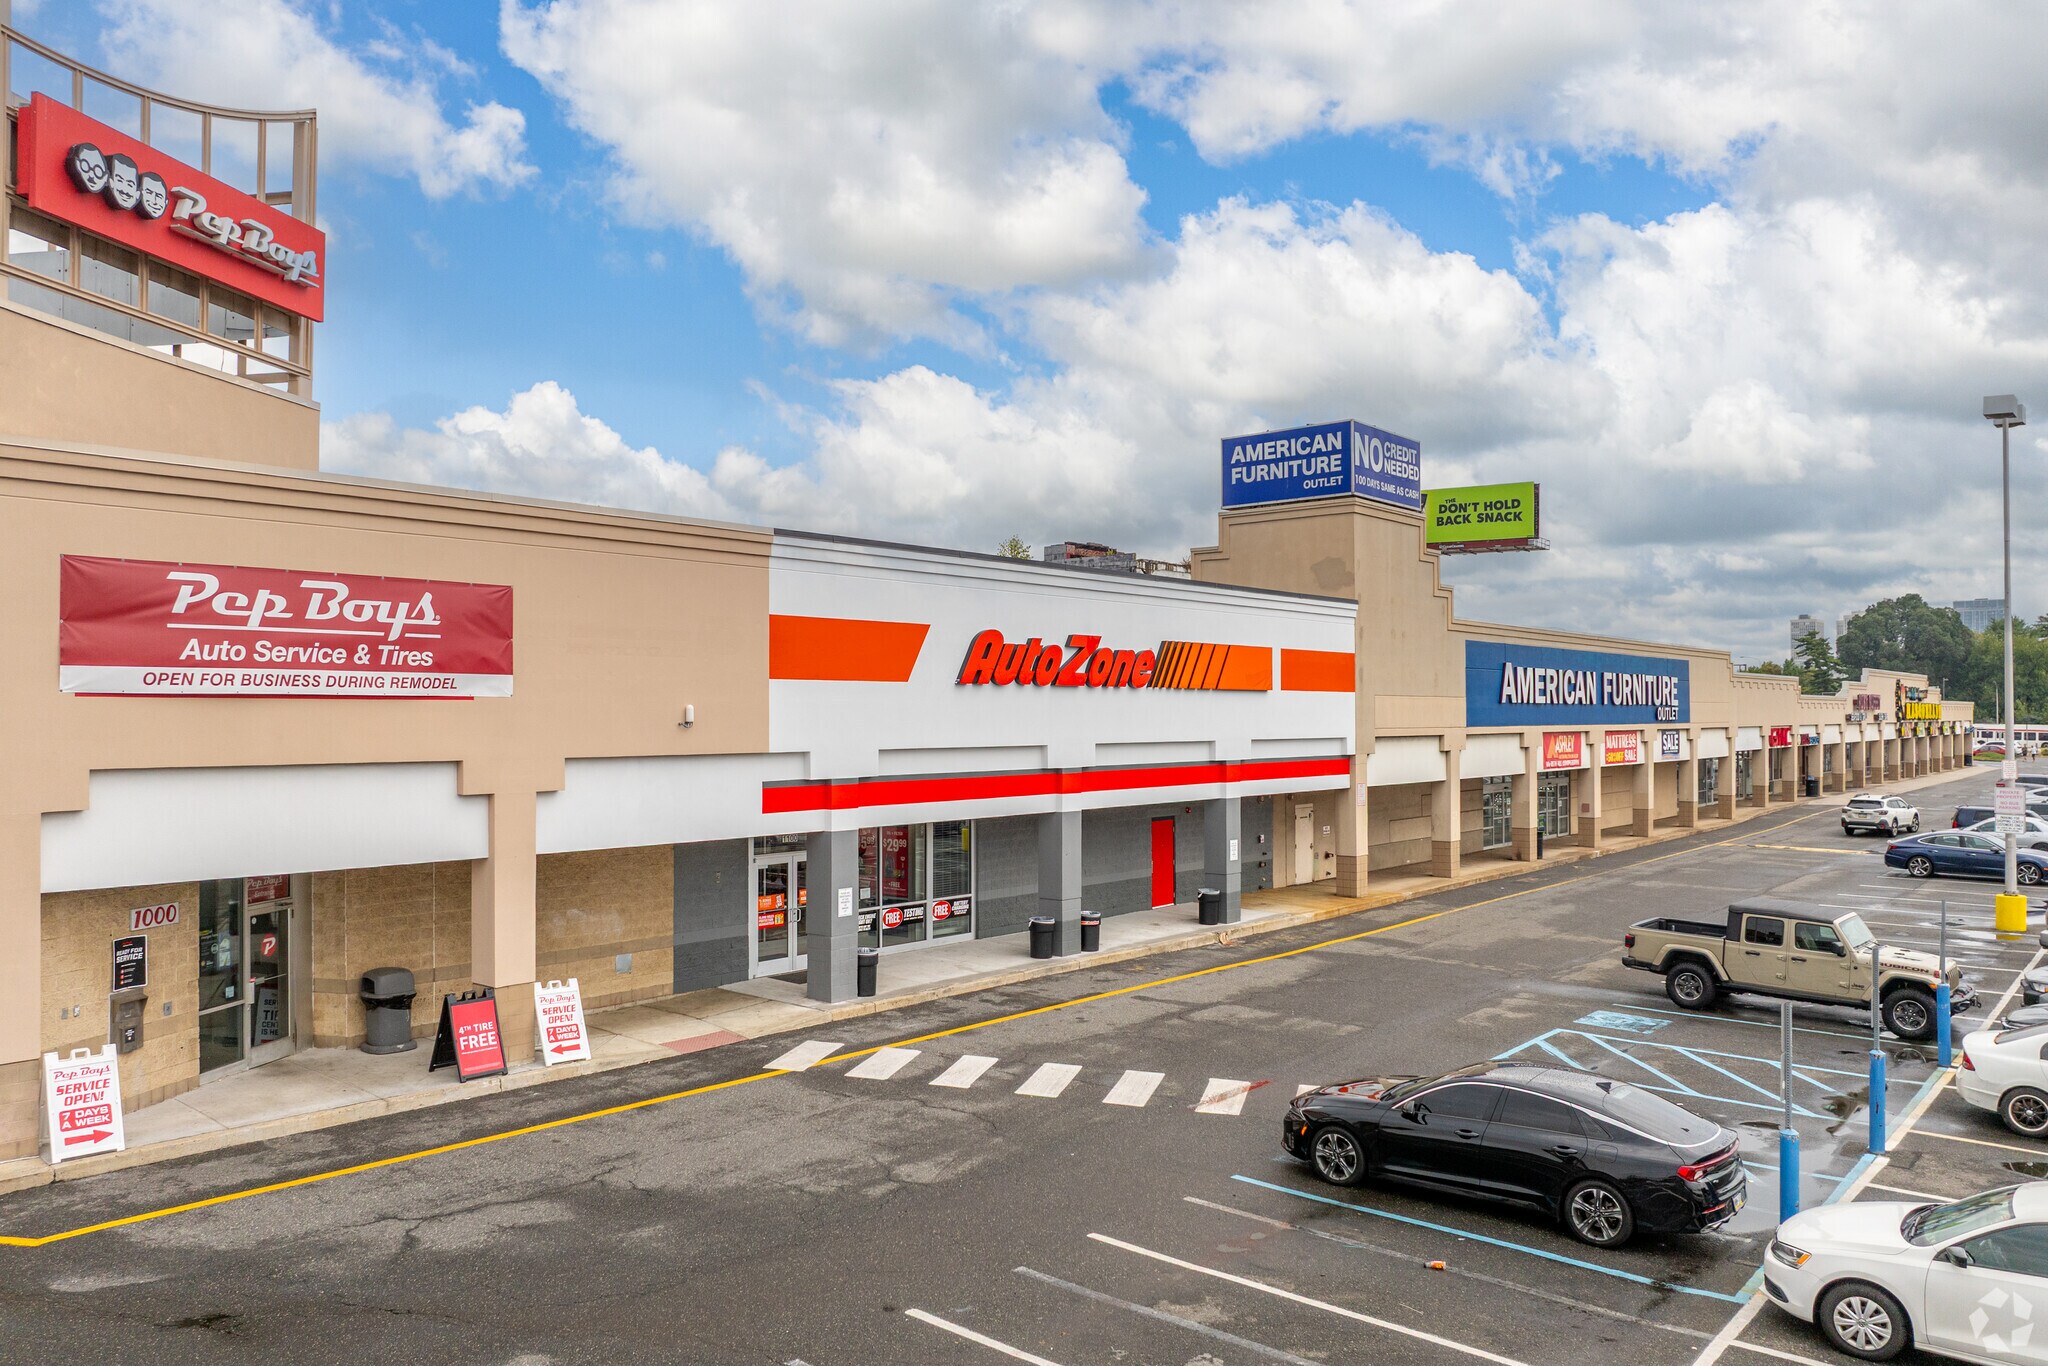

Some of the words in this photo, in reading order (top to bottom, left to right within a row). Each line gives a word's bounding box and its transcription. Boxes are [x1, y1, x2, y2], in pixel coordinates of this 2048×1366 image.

[171, 186, 244, 245] Pep
[241, 219, 319, 281] Boys
[1231, 431, 1342, 464] AMERICAN
[1354, 431, 1384, 473] NO
[1384, 441, 1417, 464] CREDIT
[1231, 454, 1342, 485] FURNITURE
[1384, 457, 1420, 481] NEEDED
[1303, 475, 1343, 490] OUTLET
[1355, 474, 1366, 486] 100
[1366, 477, 1380, 490] DAYS
[1380, 481, 1395, 494] SAME
[1396, 486, 1404, 496] AS
[1404, 487, 1419, 500] CASH
[1438, 502, 1479, 514] DON'T
[1483, 499, 1521, 511] HOLD
[1436, 513, 1472, 527] BACK
[1476, 511, 1523, 523] SNACK
[166, 571, 294, 628] Pep
[300, 579, 441, 642] Boys
[179, 638, 247, 662] Auto
[253, 640, 347, 664] Service
[353, 644, 371, 665] &
[378, 645, 434, 667] Tires
[955, 628, 1156, 689] AutoZone
[142, 671, 194, 687] OPEN
[200, 673, 235, 687] FOR
[241, 674, 321, 688] BUSINESS
[325, 676, 385, 690] DURING
[388, 677, 458, 690] REMODEL
[1501, 662, 1597, 706] AMERICAN
[1602, 672, 1679, 707] FURNITURE
[1656, 706, 1679, 721] OUTLET
[1555, 735, 1575, 753] ASHLEY
[1606, 733, 1637, 749] MATTRESS
[1662, 734, 1679, 751] SALE
[1624, 749, 1637, 761] SALE
[264, 876, 283, 886] Boys
[134, 904, 177, 929] 1000
[885, 912, 900, 925] FREE
[904, 907, 924, 918] TESTING
[934, 904, 948, 917] FREE
[116, 949, 130, 957] READY
[116, 952, 144, 964] SERVICE
[539, 996, 555, 1004] Pep
[556, 993, 576, 1002] Boys
[542, 1004, 576, 1016] SERVICE
[548, 1013, 573, 1024] OPEN!
[458, 1025, 472, 1035] 4TH
[473, 1021, 494, 1032] TIRE
[555, 1025, 578, 1033] DAYS
[556, 1031, 579, 1040] WEEK
[460, 1031, 497, 1051] FREE
[54, 1071, 79, 1080] Pep
[80, 1065, 111, 1076] Boys
[56, 1078, 110, 1096] SERVICE
[64, 1091, 105, 1107] OPEN!
[62, 1112, 71, 1121] 7
[74, 1106, 109, 1119] DAYS
[62, 1121, 72, 1130] A
[74, 1114, 110, 1127] WEEK
